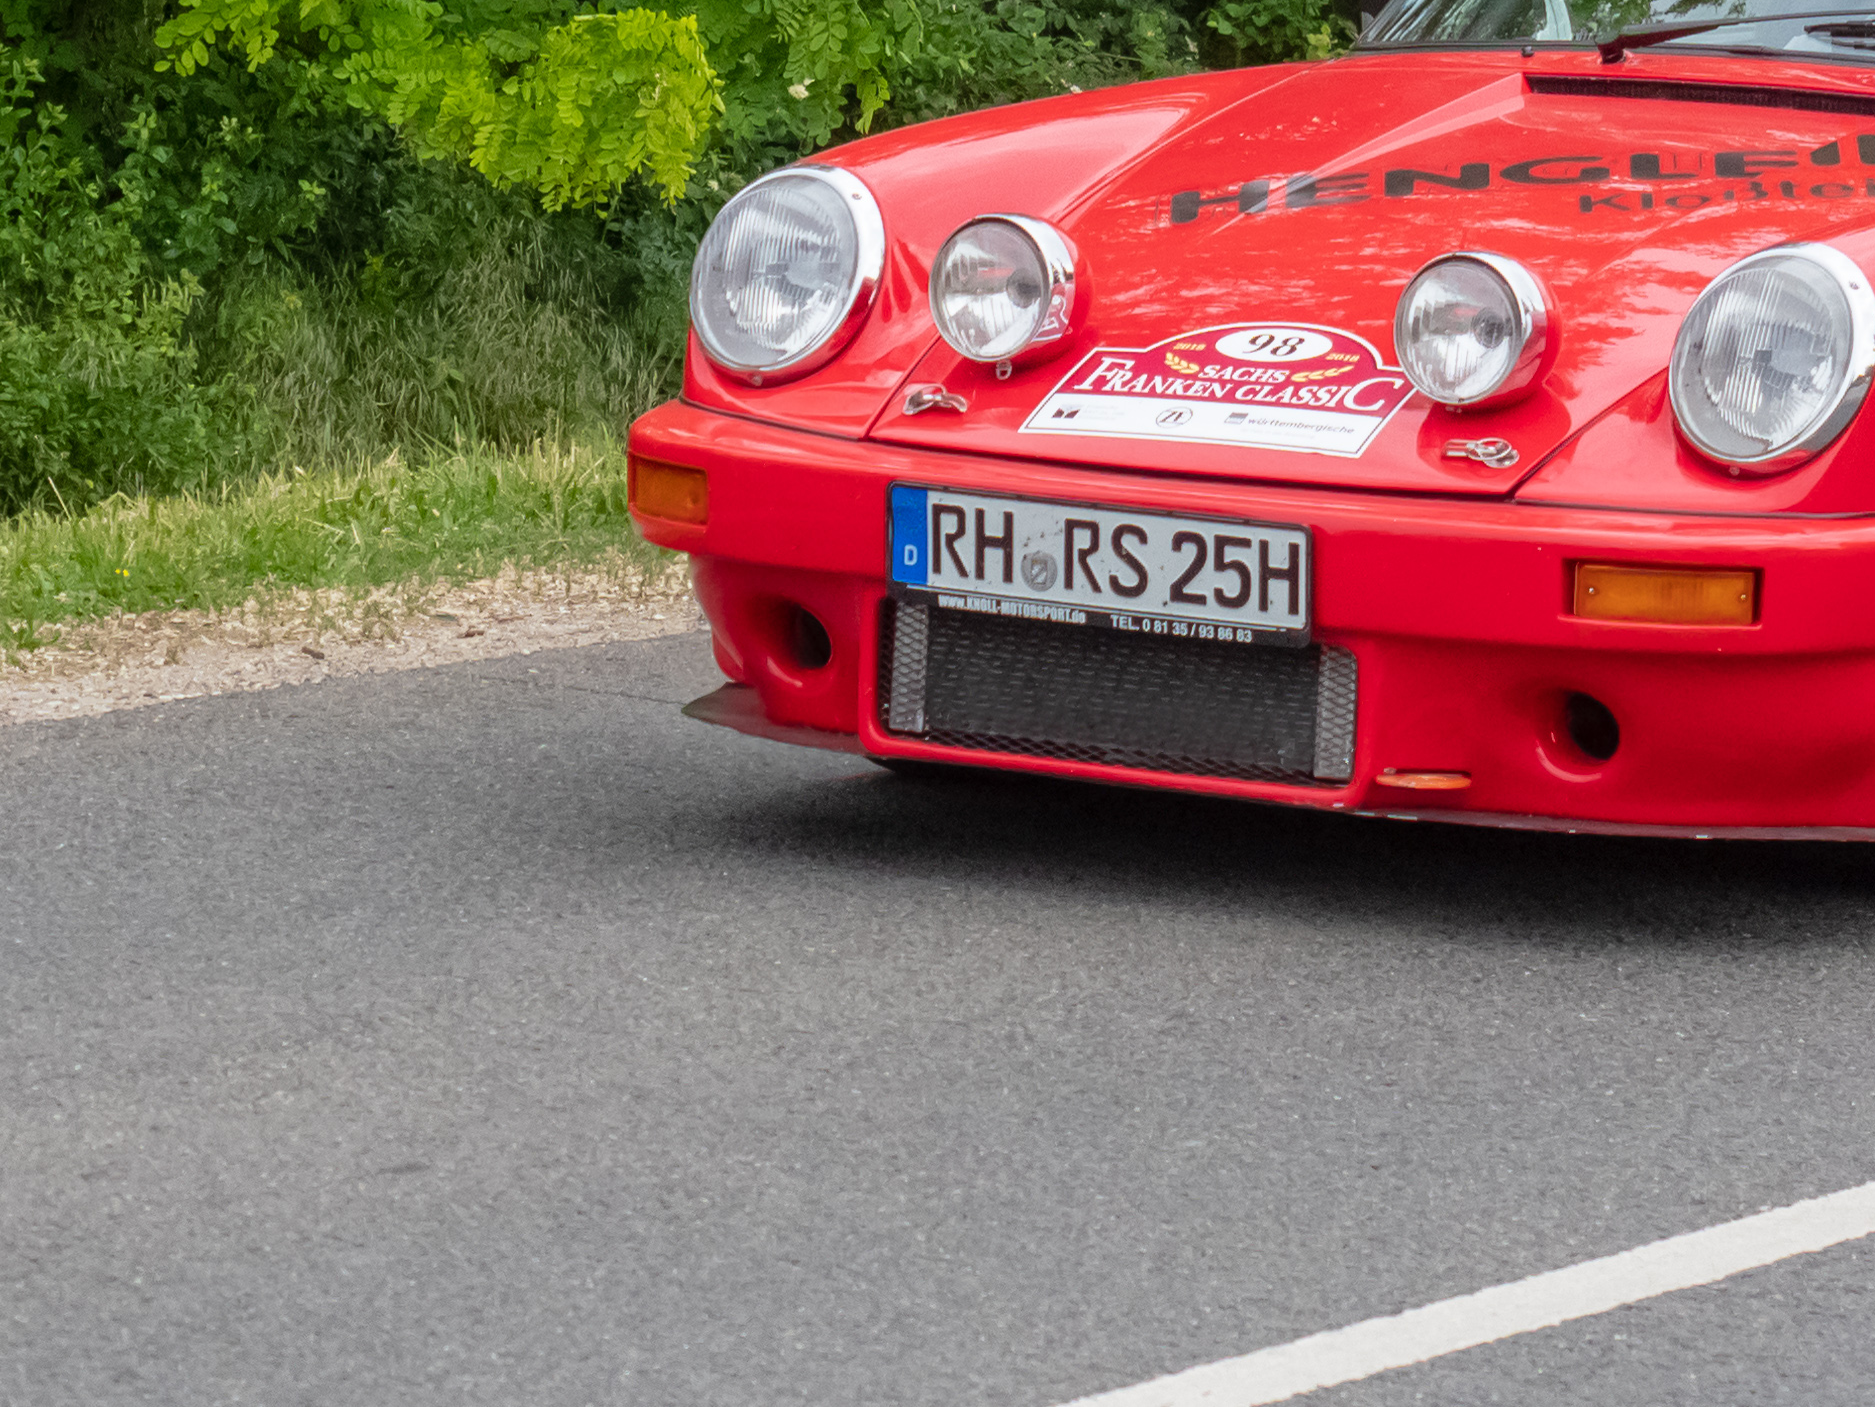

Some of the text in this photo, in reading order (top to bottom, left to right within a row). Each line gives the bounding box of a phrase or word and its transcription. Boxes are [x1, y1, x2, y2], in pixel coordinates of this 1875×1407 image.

[1242, 333, 1306, 357] 98
[1072, 357, 1404, 412] FRANKEN CLASSIC
[1198, 364, 1290, 383] SACHS
[1248, 418, 1355, 434] württembergische
[904, 545, 918, 565] D
[932, 503, 1301, 615] RH RS 25H
[937, 594, 1087, 624] www.KNOLL-MOTORSPORT.de
[1110, 614, 1140, 631] TEL.
[1142, 618, 1151, 632] 0
[1153, 619, 1168, 634] 81
[1172, 621, 1188, 636] 35
[1199, 624, 1215, 638] 93
